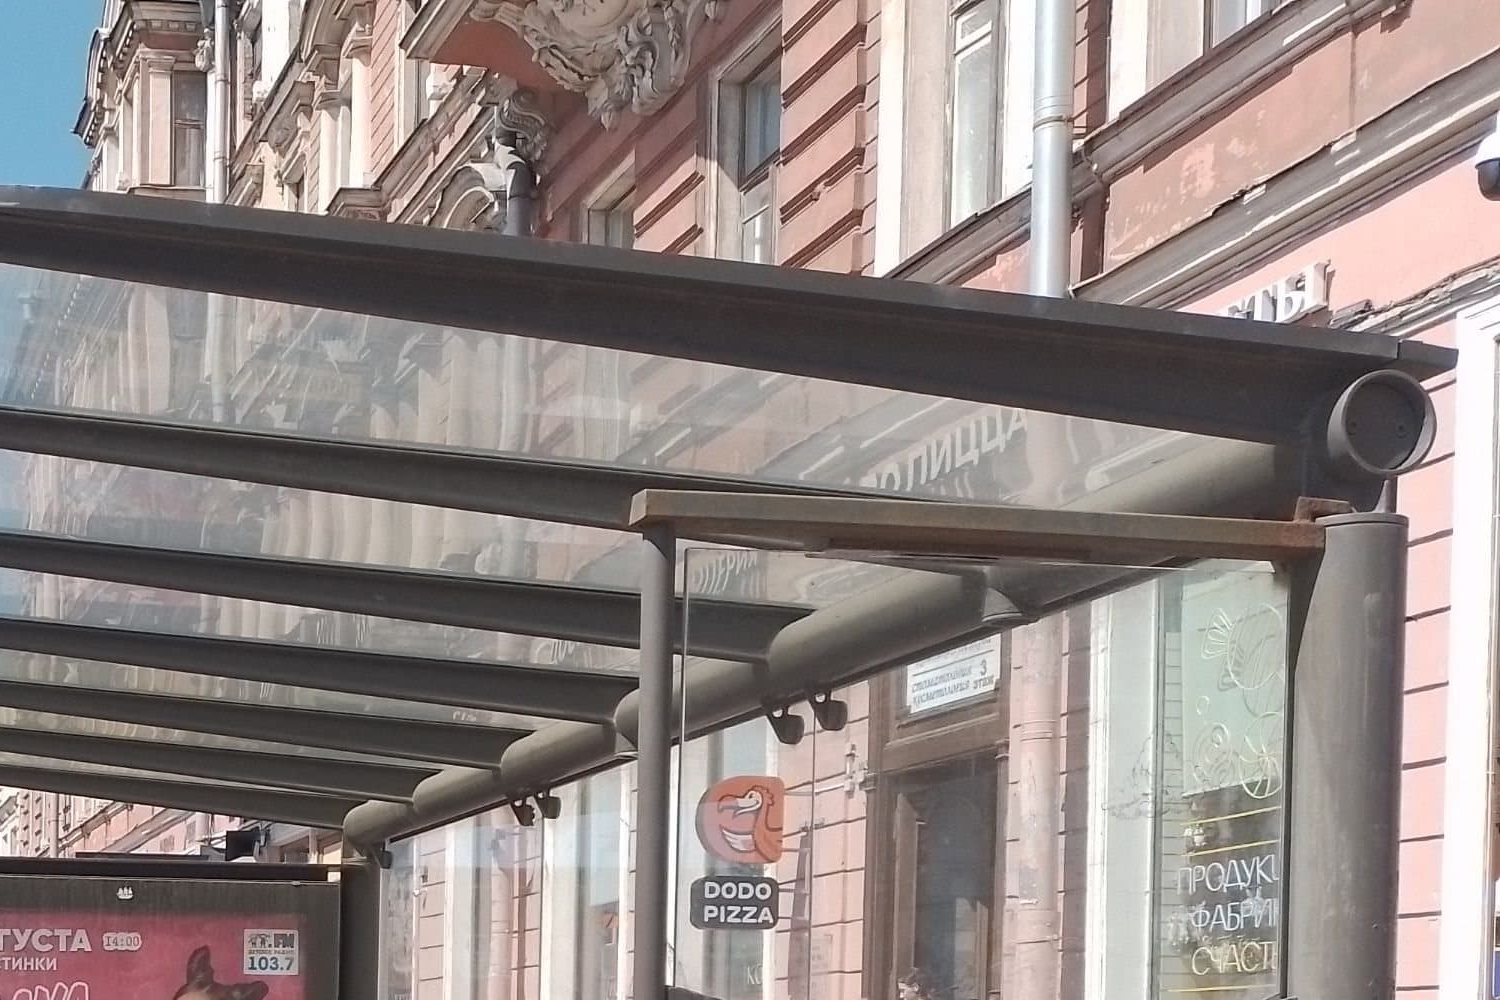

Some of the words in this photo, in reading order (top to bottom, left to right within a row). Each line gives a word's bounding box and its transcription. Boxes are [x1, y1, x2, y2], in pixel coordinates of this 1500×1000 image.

[704, 882, 772, 900] DODO
[703, 905, 774, 923] PIZZA
[1191, 898, 1277, 932] ФАБРИ
[105, 936, 140, 947] 14:00
[248, 956, 294, 970] 103.7
